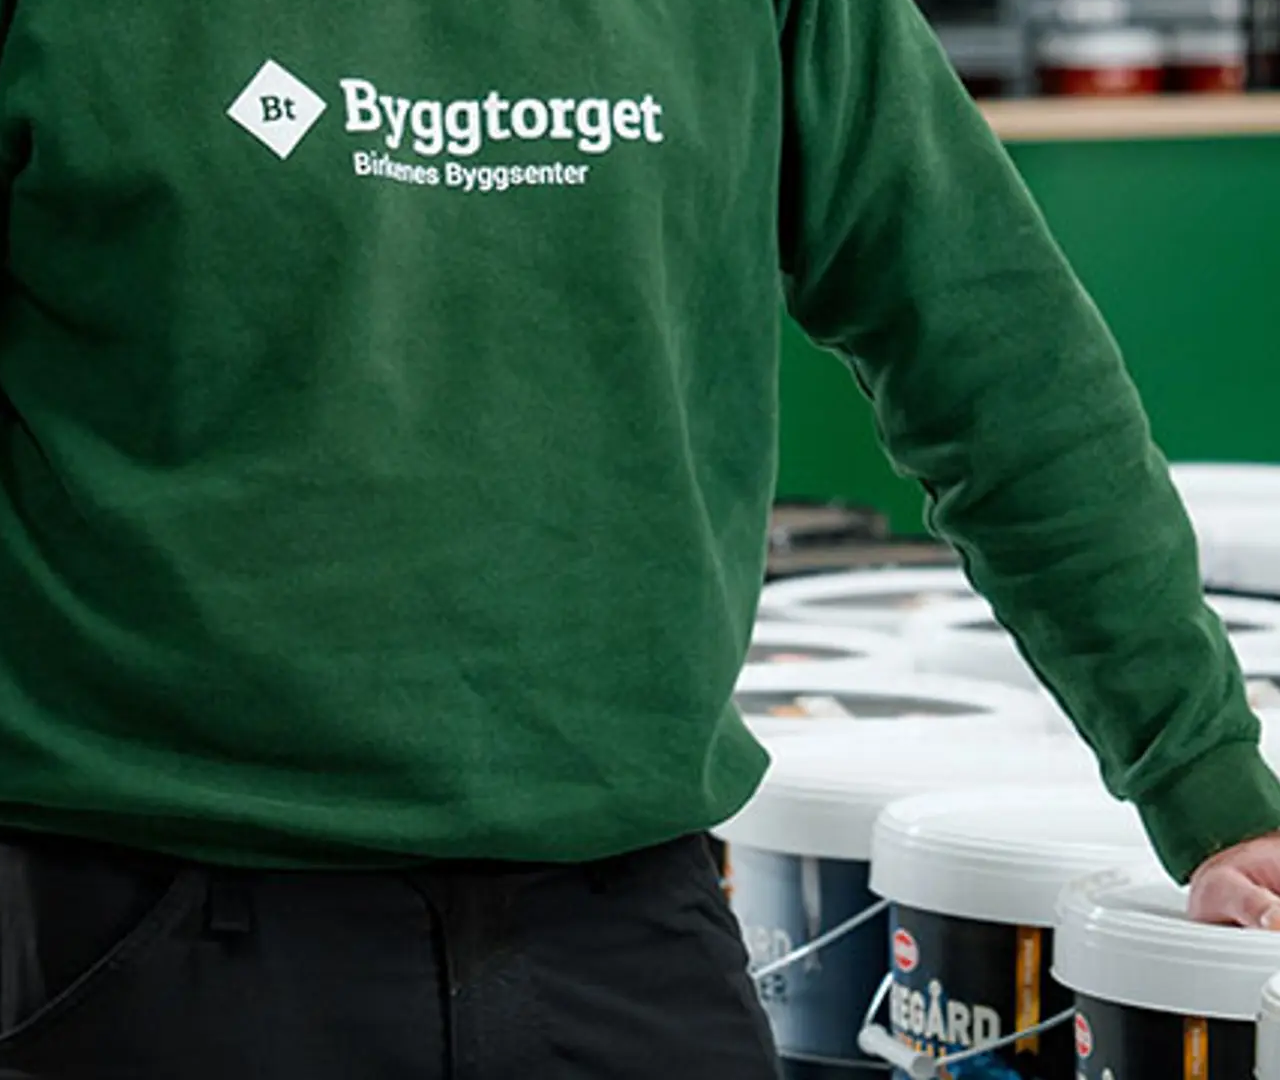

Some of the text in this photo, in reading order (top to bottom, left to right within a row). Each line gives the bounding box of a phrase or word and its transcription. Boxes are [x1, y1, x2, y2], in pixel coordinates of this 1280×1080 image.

[260, 95, 297, 123] Bt
[339, 78, 663, 156] Byggtorget
[444, 161, 590, 192] Byggsenter
